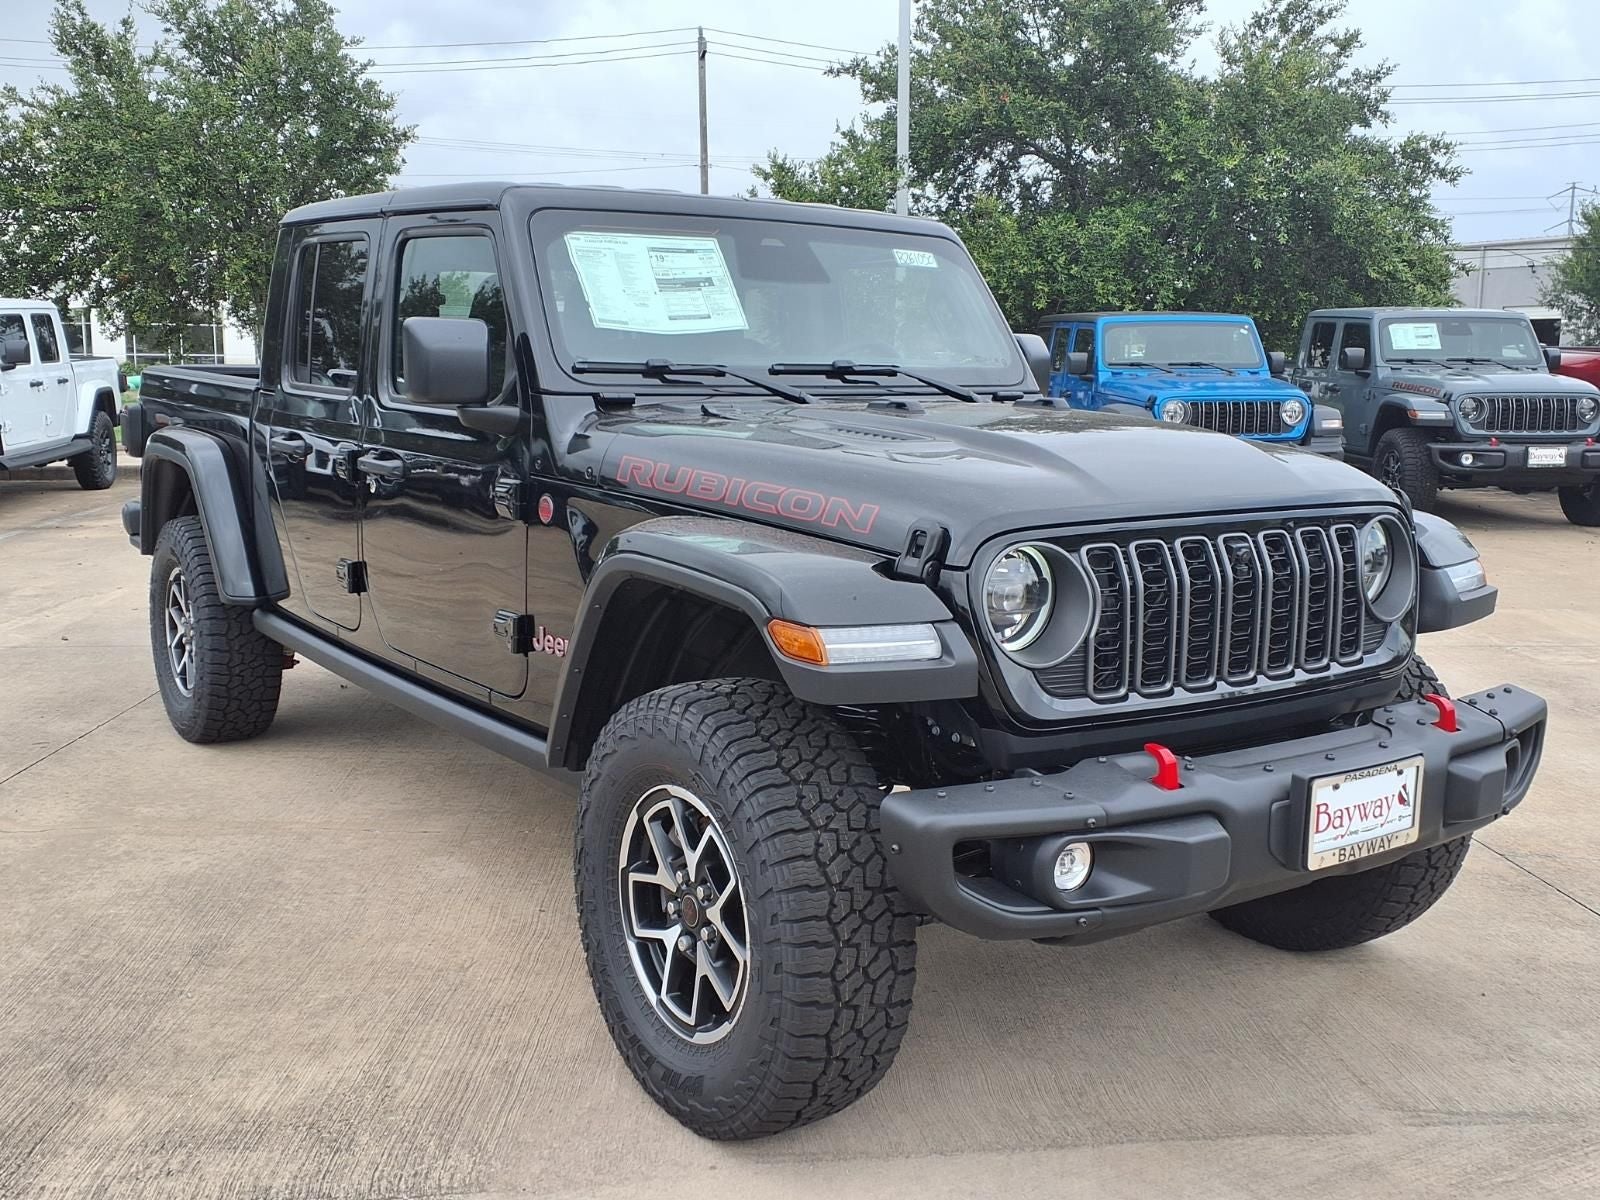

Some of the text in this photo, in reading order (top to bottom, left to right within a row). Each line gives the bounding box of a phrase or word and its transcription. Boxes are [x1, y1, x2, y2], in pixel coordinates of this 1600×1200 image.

[1392, 381, 1441, 396] RUBICON
[616, 455, 880, 534] RUBICON
[1344, 764, 1398, 782] PASADENA
[1314, 794, 1395, 839] Bayway
[1338, 834, 1394, 862] BAYWAY
